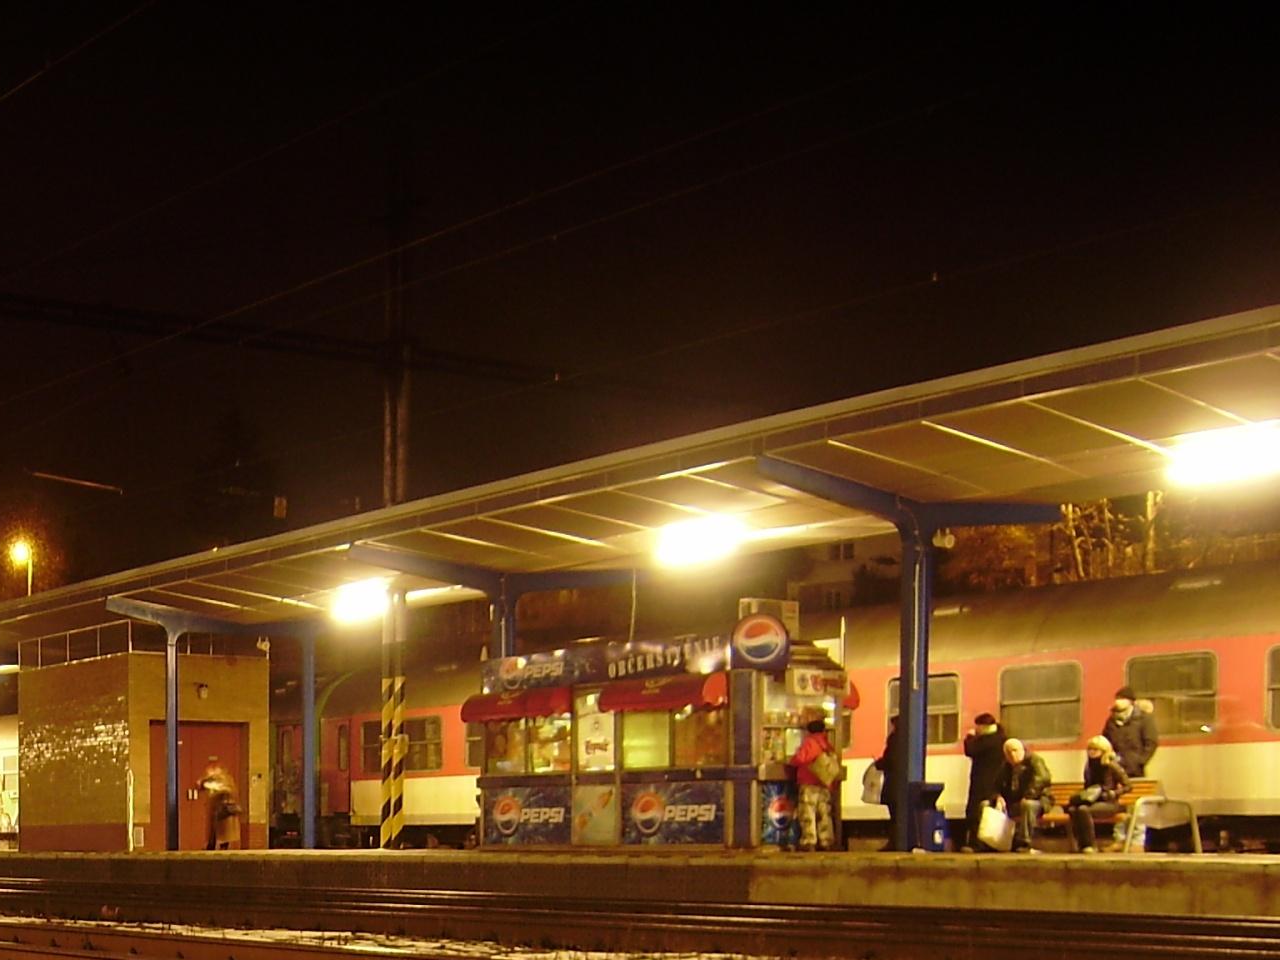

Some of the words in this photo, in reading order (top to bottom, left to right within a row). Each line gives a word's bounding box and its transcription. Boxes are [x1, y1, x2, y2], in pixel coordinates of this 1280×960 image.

[524, 661, 565, 679] PEPSI
[519, 806, 565, 824] PEPSI
[663, 803, 717, 822] PEPSI
